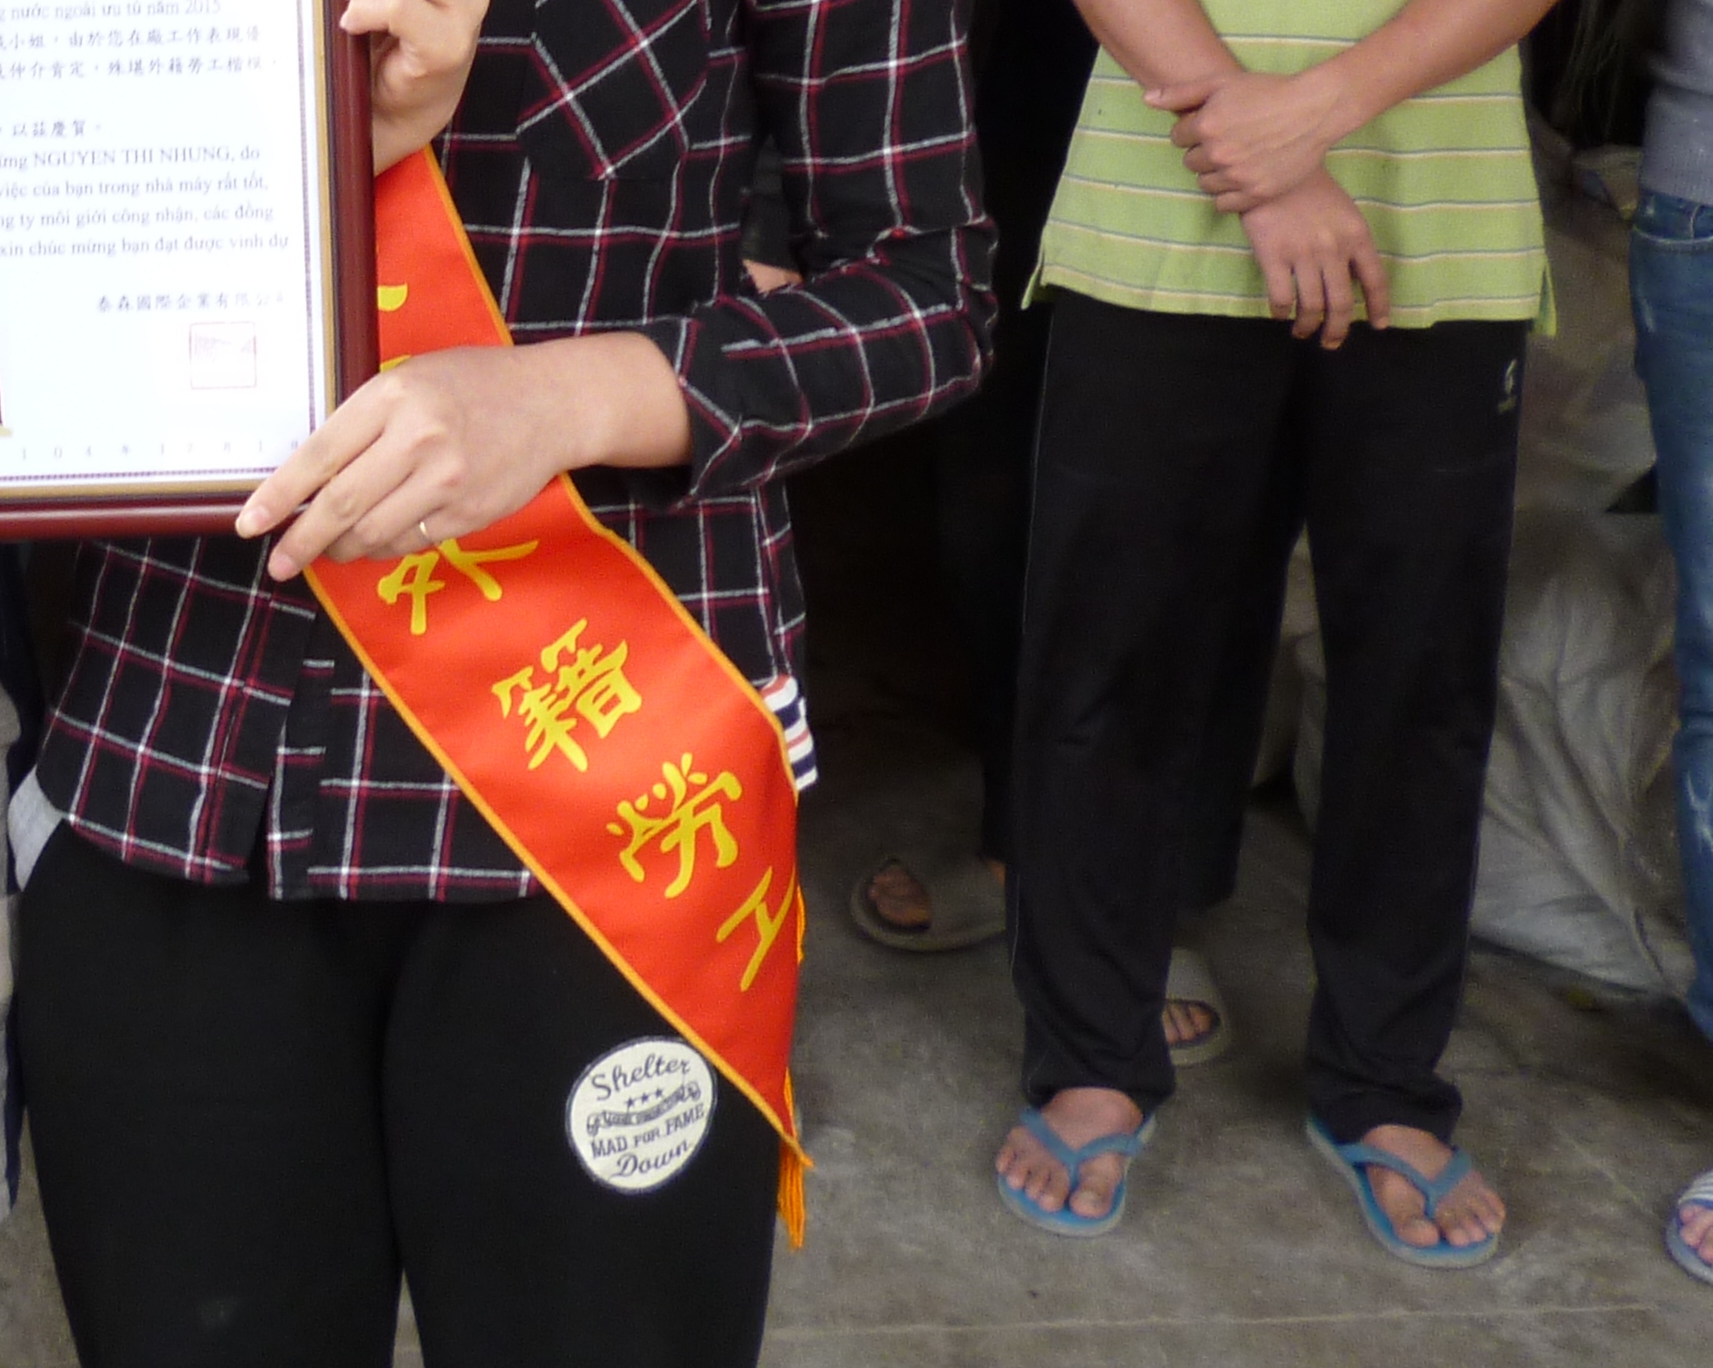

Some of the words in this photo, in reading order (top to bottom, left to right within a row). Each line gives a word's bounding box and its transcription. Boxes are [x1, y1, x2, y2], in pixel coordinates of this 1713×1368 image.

[160, 145, 235, 164] NHUNG,
[240, 145, 260, 161] do
[65, 179, 93, 198] bạn
[99, 181, 140, 198] trong
[19, 213, 35, 232] ty
[40, 208, 70, 226] môi
[111, 207, 150, 227] công
[203, 202, 229, 220] các
[28, 238, 66, 256] chúc
[122, 235, 150, 255] bạn
[184, 234, 224, 254] được
[229, 232, 263, 251] vinh
[591, 1053, 691, 1102] Shelter
[591, 1135, 628, 1159] MAD
[634, 1127, 661, 1148] FOR
[665, 1102, 705, 1137] FAME
[608, 1139, 690, 1182] Down
